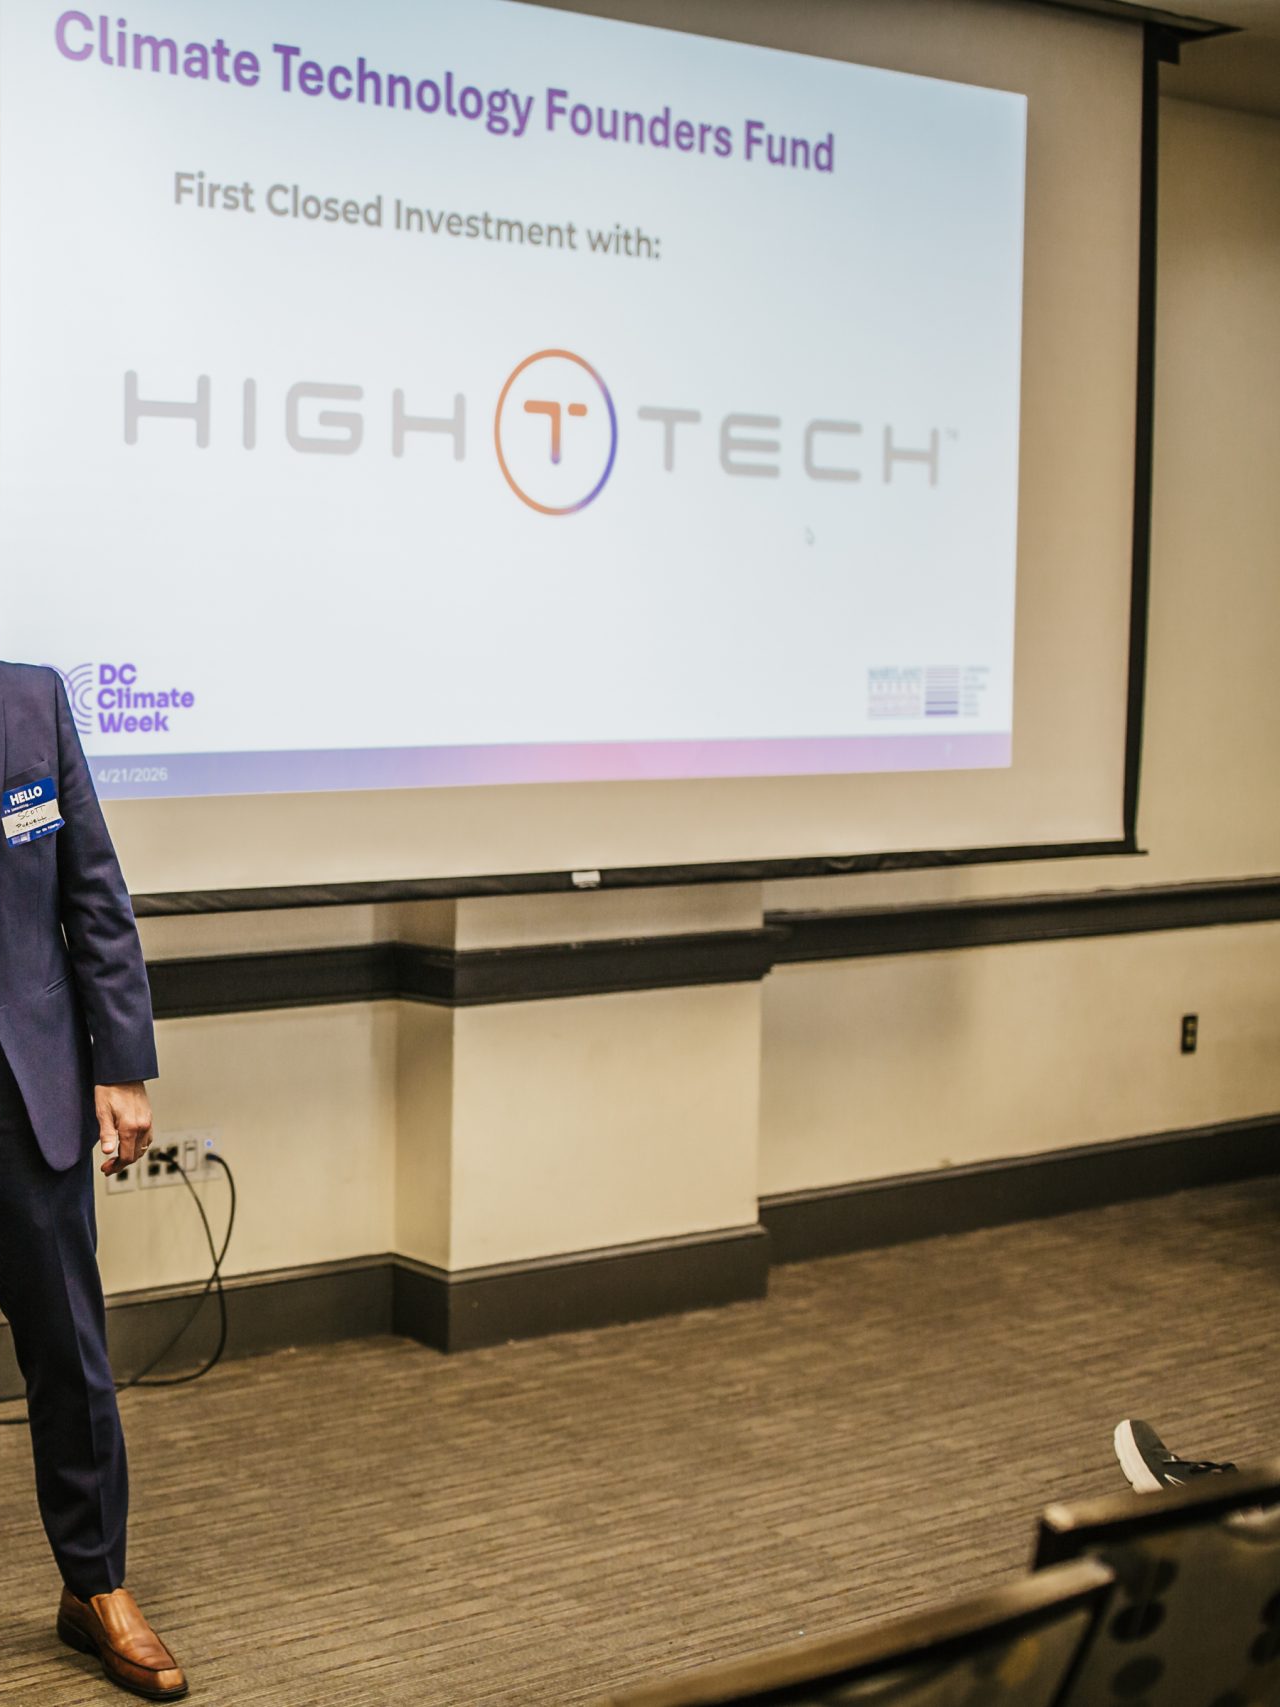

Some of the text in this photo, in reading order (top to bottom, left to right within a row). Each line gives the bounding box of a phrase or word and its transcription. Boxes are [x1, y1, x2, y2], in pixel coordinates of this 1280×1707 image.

[55, 10, 835, 173] Climate Technology Founders Fund
[174, 170, 661, 259] First Closed Investment with:
[123, 369, 467, 462] HIGH
[637, 405, 941, 488] TECH
[99, 663, 137, 685] DC
[97, 687, 195, 710] Climate
[98, 711, 169, 733] Week
[98, 767, 168, 783] 4/21/2026
[9, 786, 43, 806] HELLO
